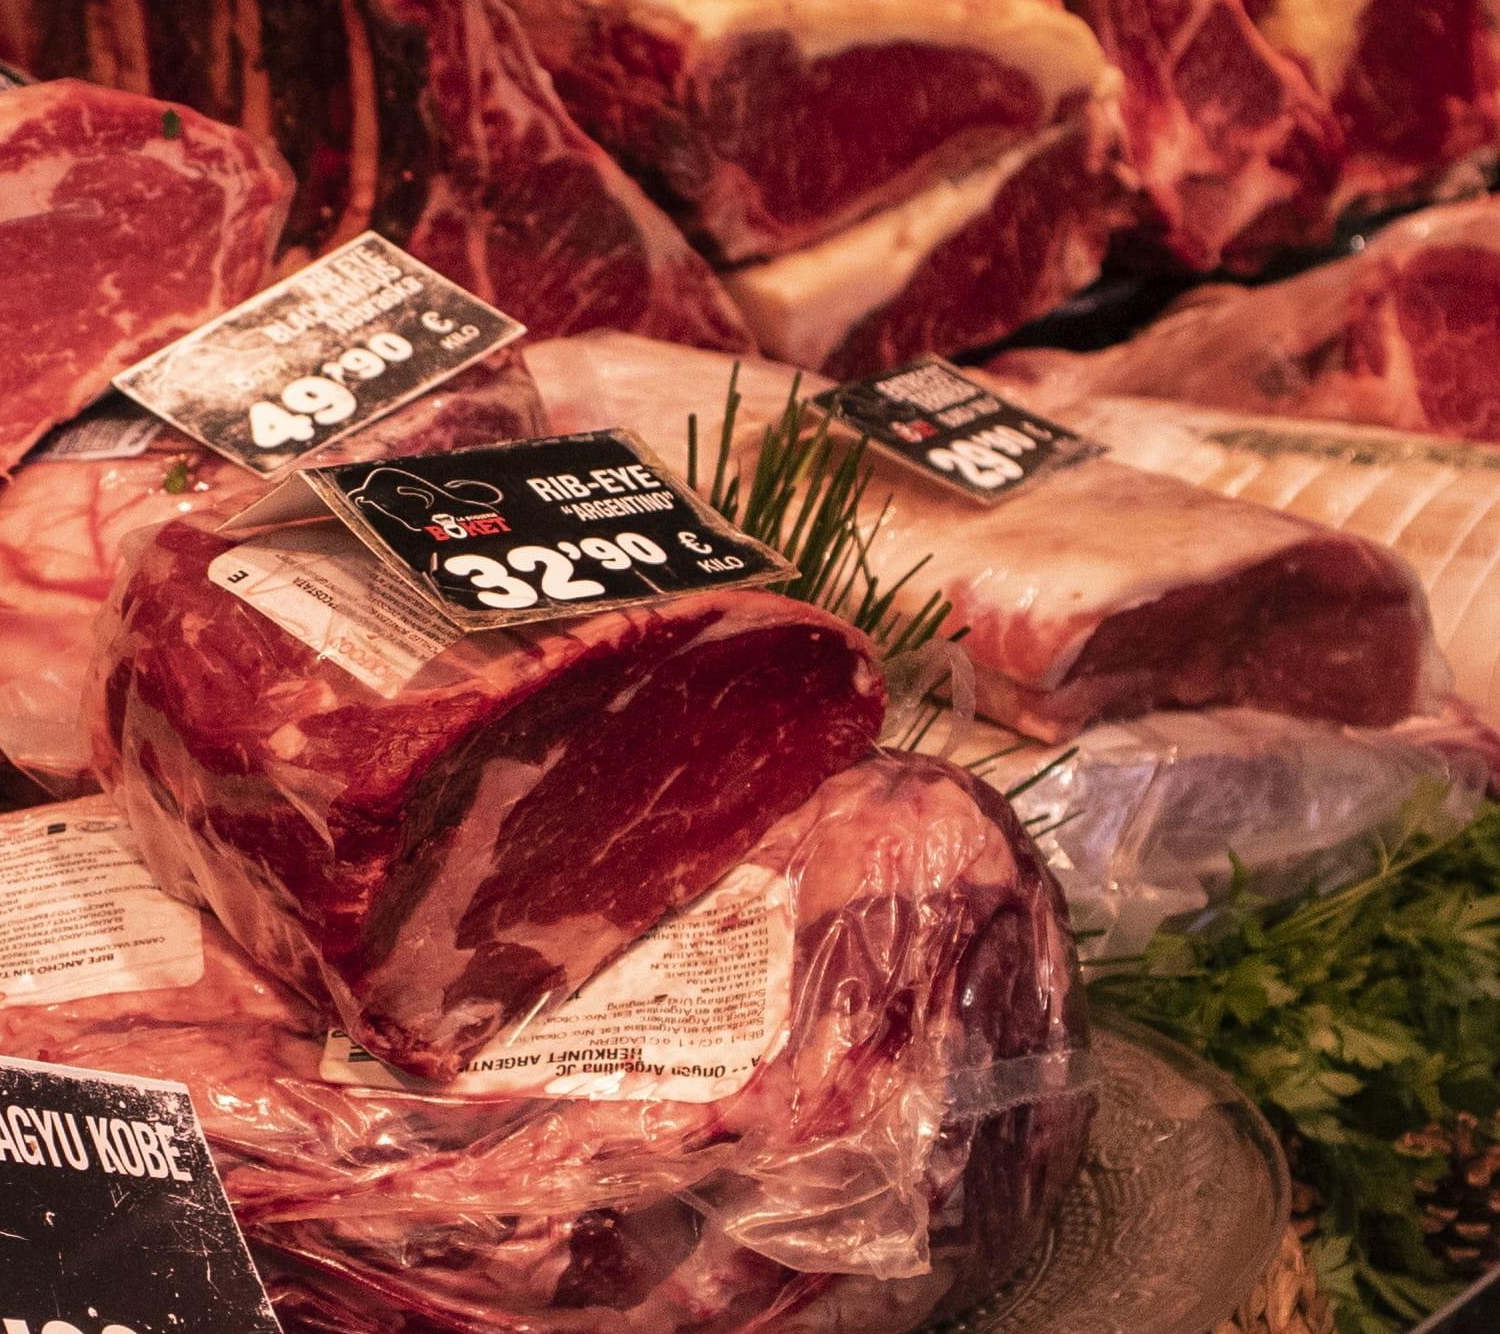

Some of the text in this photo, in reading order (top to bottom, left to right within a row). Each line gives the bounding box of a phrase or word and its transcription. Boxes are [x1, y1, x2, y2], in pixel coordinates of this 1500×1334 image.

[526, 463, 663, 504] RIB-EYE
[696, 555, 745, 575] KILO
[36, 958, 84, 974] ANCHO
[87, 953, 114, 964] BIFE
[546, 1048, 642, 1063] HERKUNFT
[84, 1116, 194, 1184] KOBE
